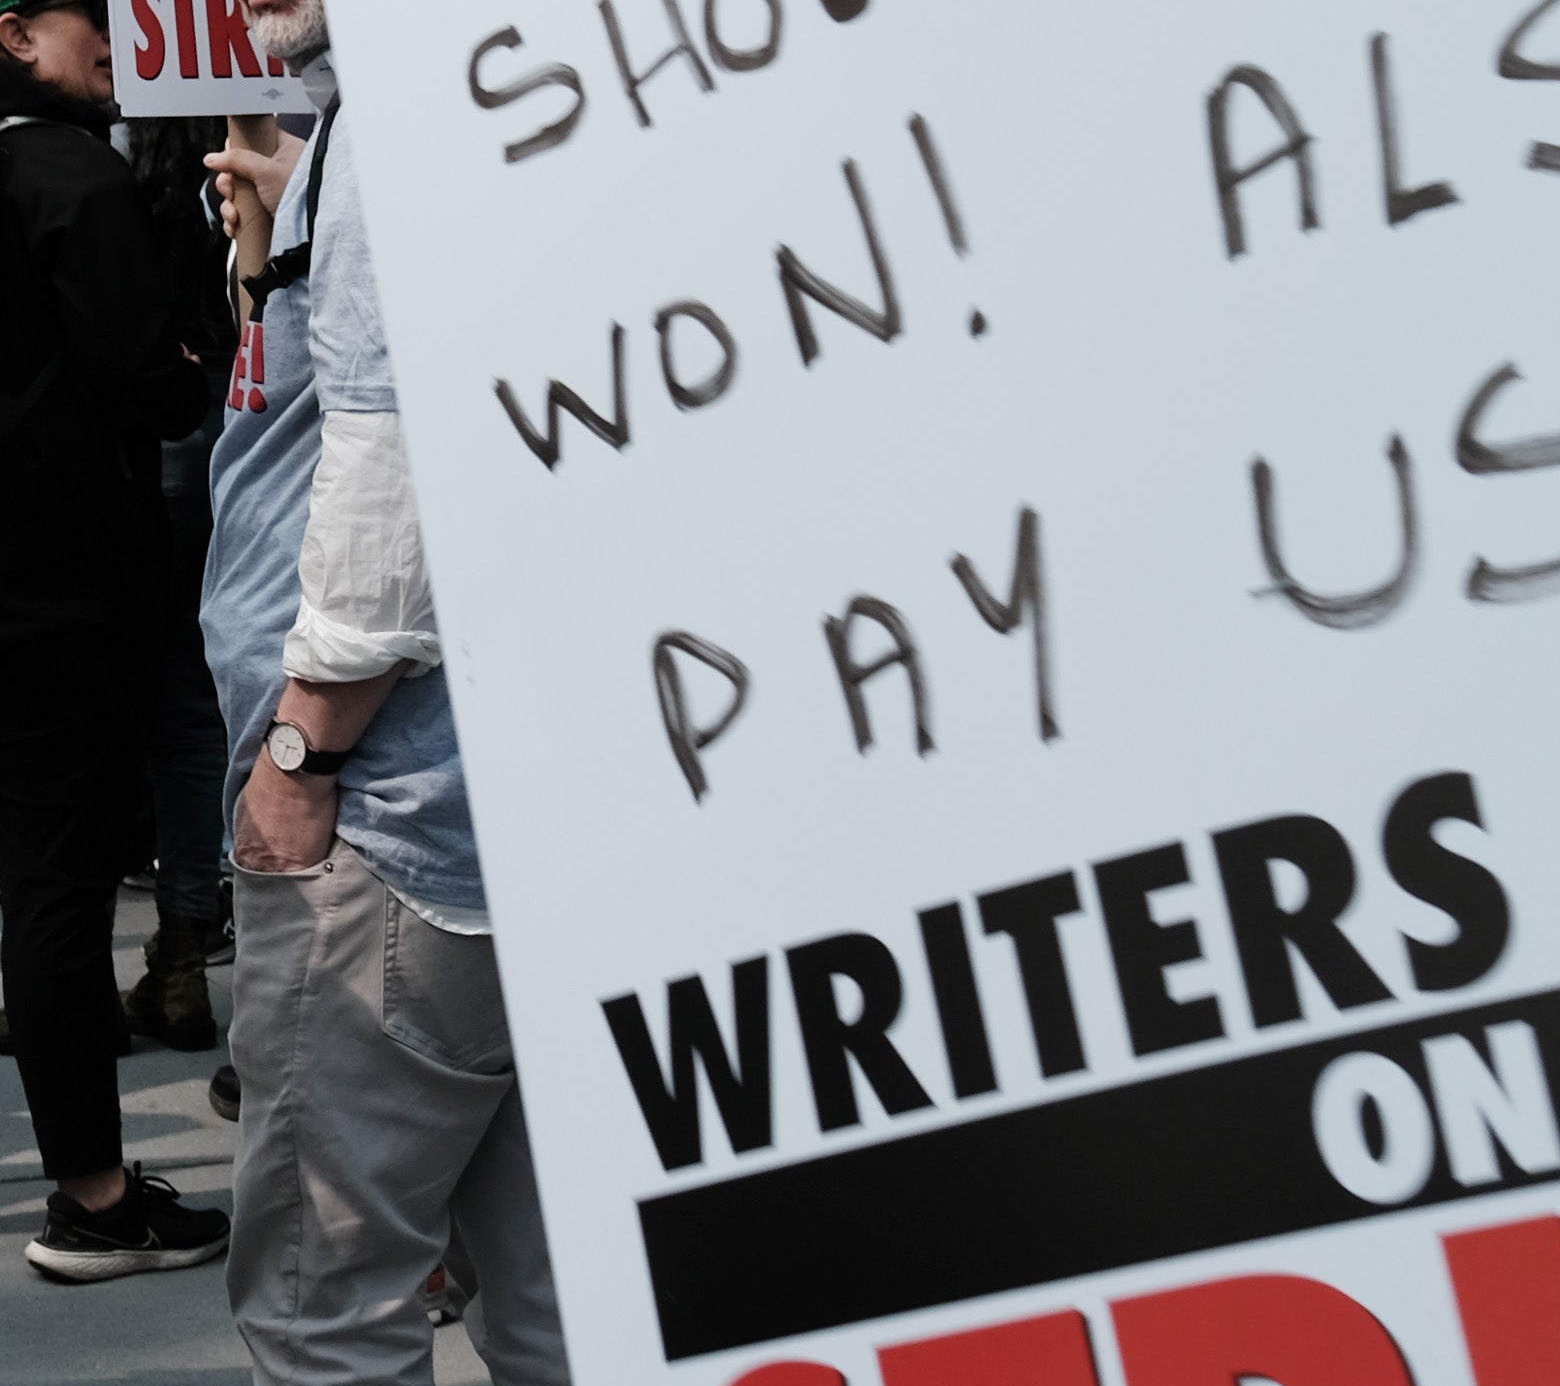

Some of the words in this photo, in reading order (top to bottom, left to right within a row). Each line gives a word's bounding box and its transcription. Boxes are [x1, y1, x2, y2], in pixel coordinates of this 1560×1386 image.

[491, 110, 996, 475] WON!
[650, 504, 1062, 804] PAY
[600, 768, 1512, 1177] WRITERS
